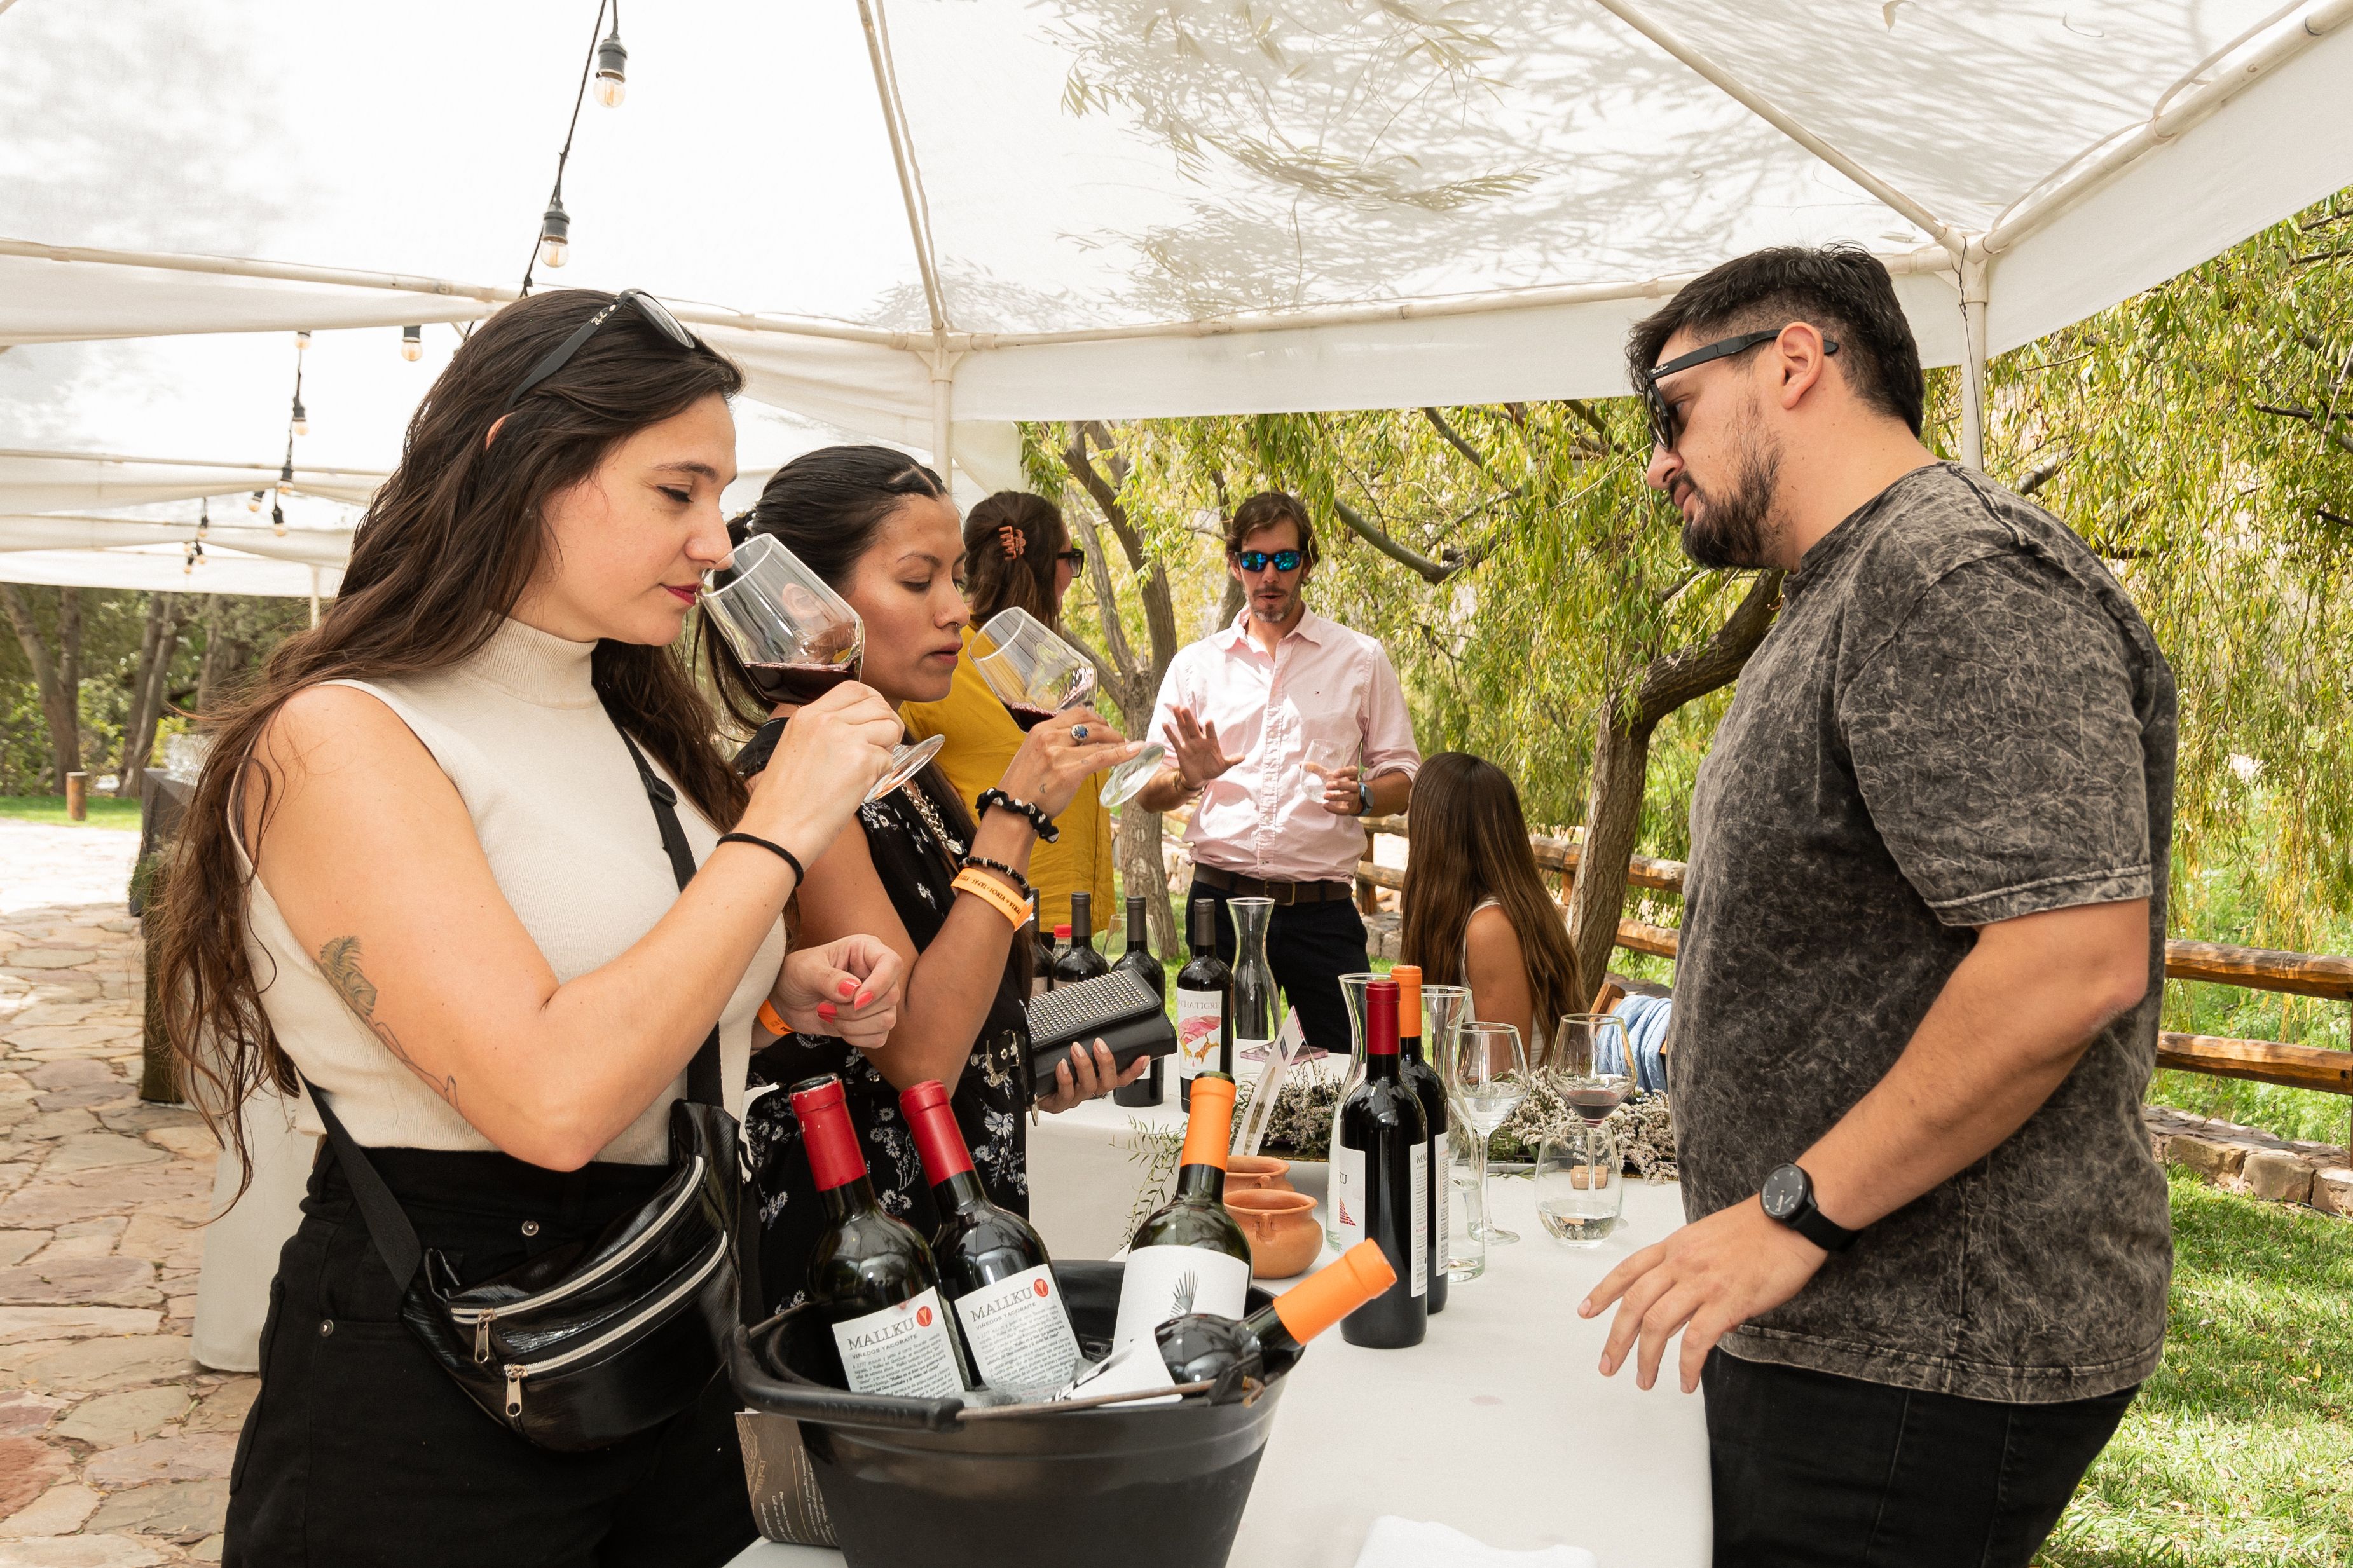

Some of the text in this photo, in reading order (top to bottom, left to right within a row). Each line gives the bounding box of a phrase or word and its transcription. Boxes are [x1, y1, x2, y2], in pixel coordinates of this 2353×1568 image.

[970, 1286, 1034, 1323] MALLKU
[975, 1316, 1003, 1330] VIÑEDOS
[1004, 1301, 1036, 1319] YACORAITE
[848, 1316, 915, 1351] MALLKU
[852, 1345, 881, 1359] VIÑEDOS
[882, 1333, 918, 1352] YACORAITE
